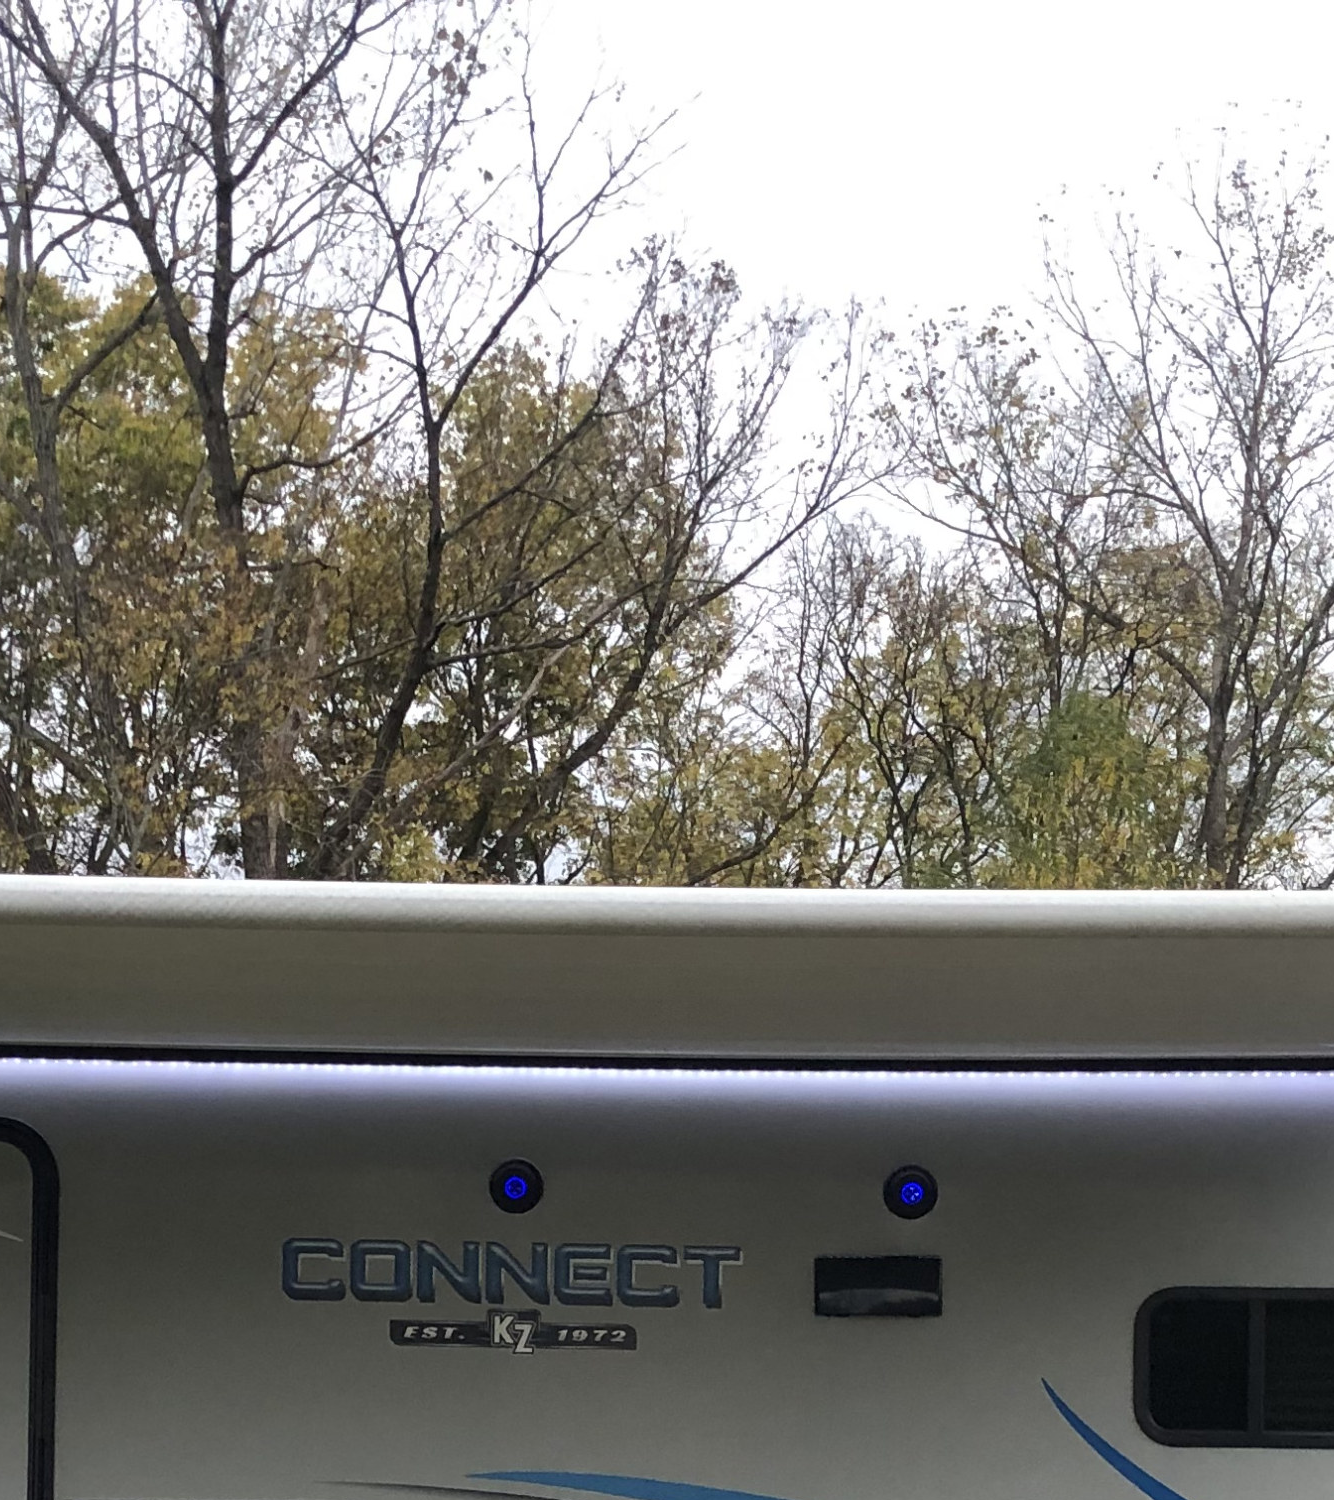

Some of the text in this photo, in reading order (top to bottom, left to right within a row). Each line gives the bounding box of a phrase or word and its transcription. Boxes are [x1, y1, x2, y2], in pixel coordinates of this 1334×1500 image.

[280, 1237, 744, 1309] CONNECT
[403, 1314, 628, 1354] EST. KZ 1972
